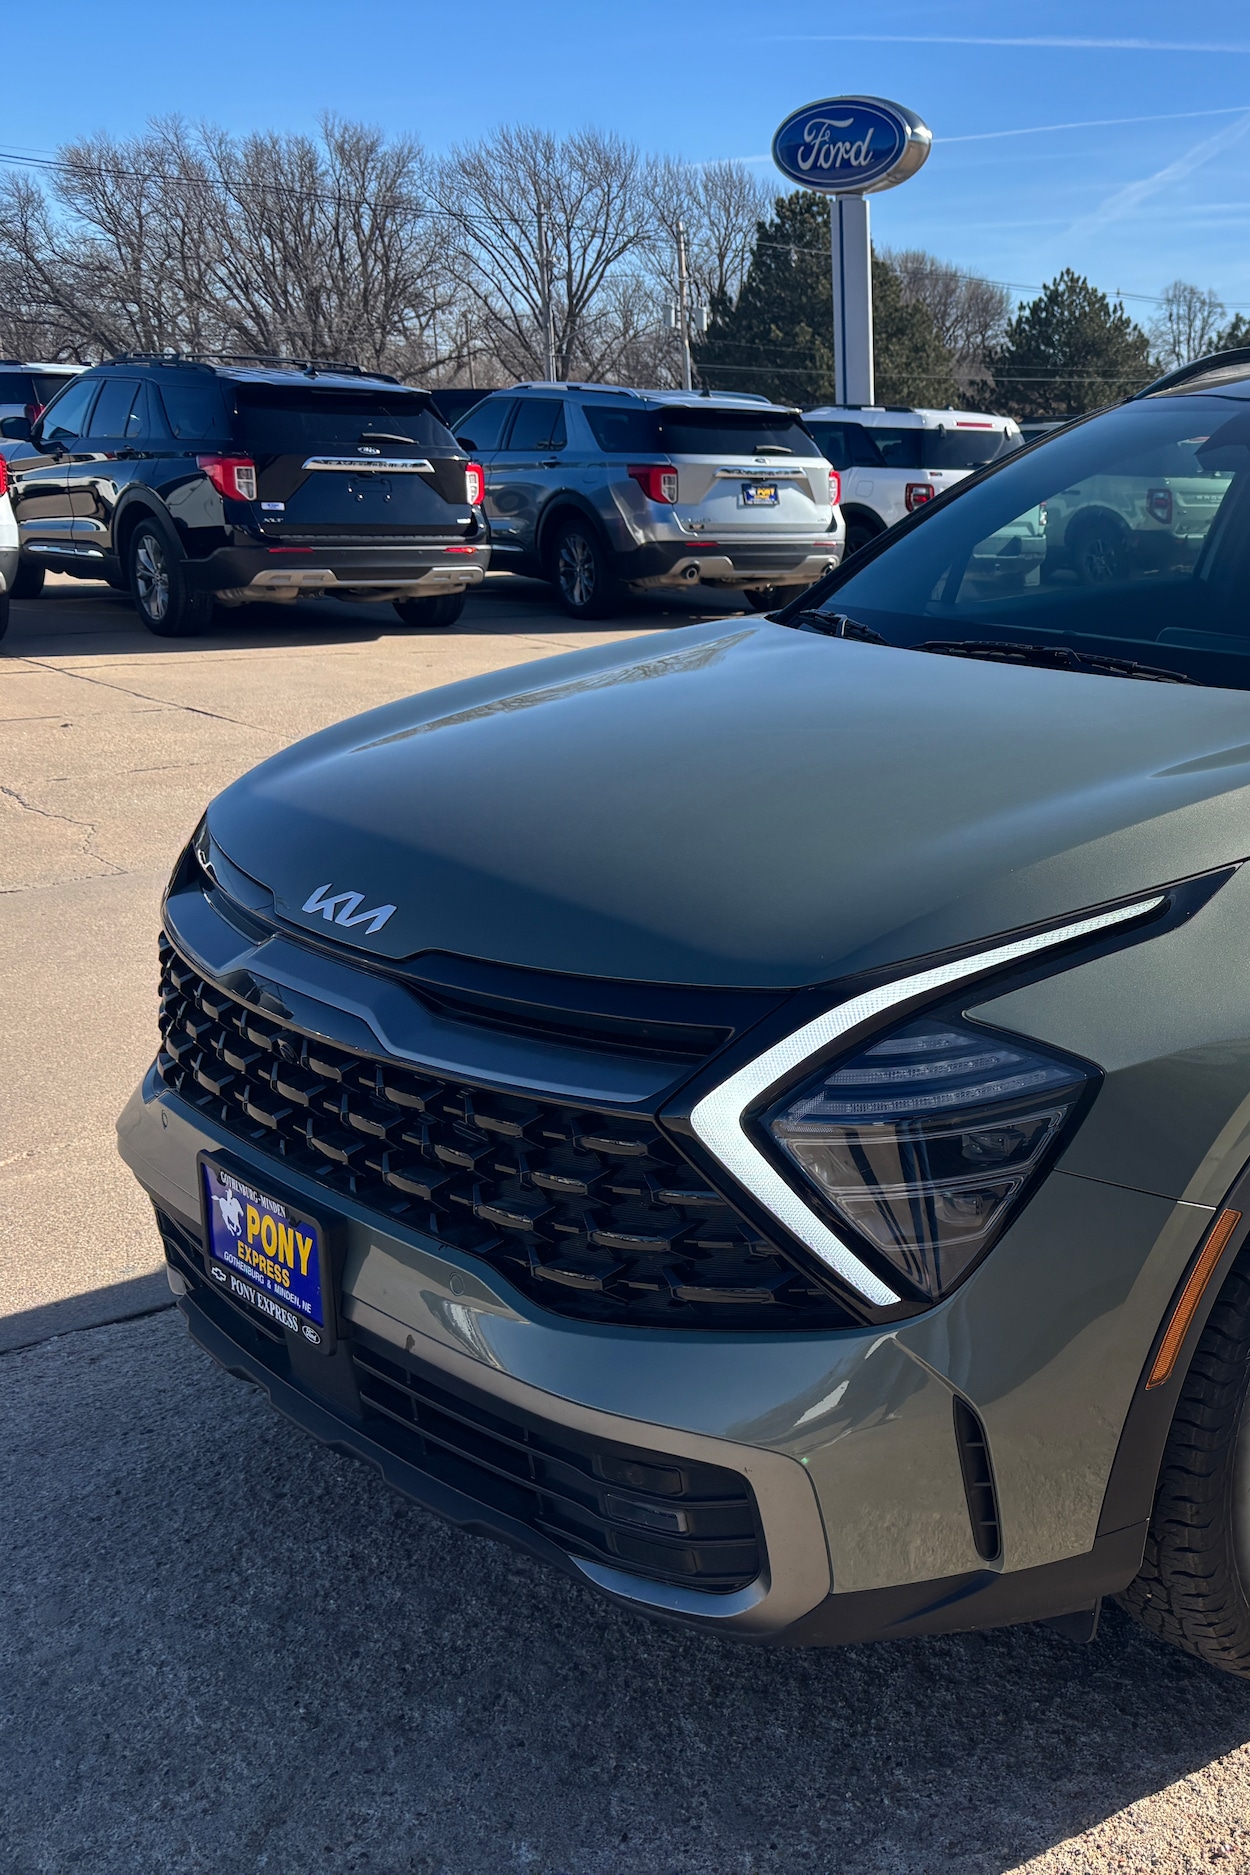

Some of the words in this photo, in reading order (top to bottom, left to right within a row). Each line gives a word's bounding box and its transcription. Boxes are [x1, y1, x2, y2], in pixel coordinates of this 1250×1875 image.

[797, 117, 874, 171] Ford
[302, 883, 398, 934] KIA
[220, 1170, 287, 1219] GOTHENBURG-MINDEN
[237, 1239, 290, 1289] EXPRESS
[246, 1203, 313, 1276] PONY
[223, 1250, 265, 1285] GOTHENBURG
[266, 1280, 272, 1290] &
[274, 1283, 302, 1308] MINDEN,
[302, 1301, 312, 1314] NE
[230, 1275, 257, 1306] PONY
[257, 1292, 299, 1333] EXPRESS
